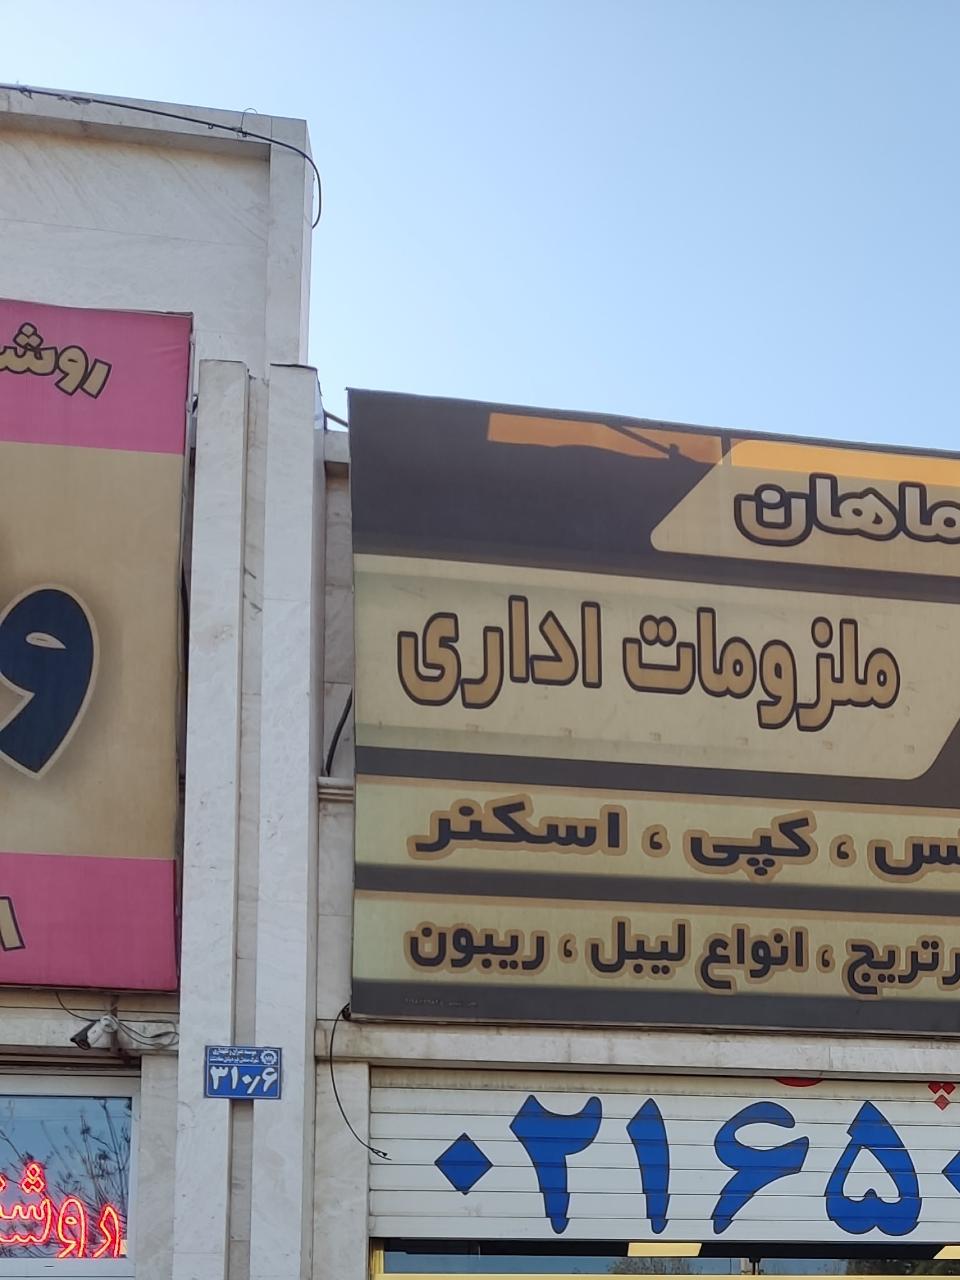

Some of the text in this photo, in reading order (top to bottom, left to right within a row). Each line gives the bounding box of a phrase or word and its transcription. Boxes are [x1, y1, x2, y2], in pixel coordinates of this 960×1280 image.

[0, 322, 112, 399] روش
[398, 595, 900, 731] ملزومات اداری
[415, 801, 620, 852] اسکنر
[689, 817, 812, 876] کپی
[409, 925, 546, 970] ریبون
[590, 922, 686, 976] لیبل
[701, 929, 805, 988] انواع
